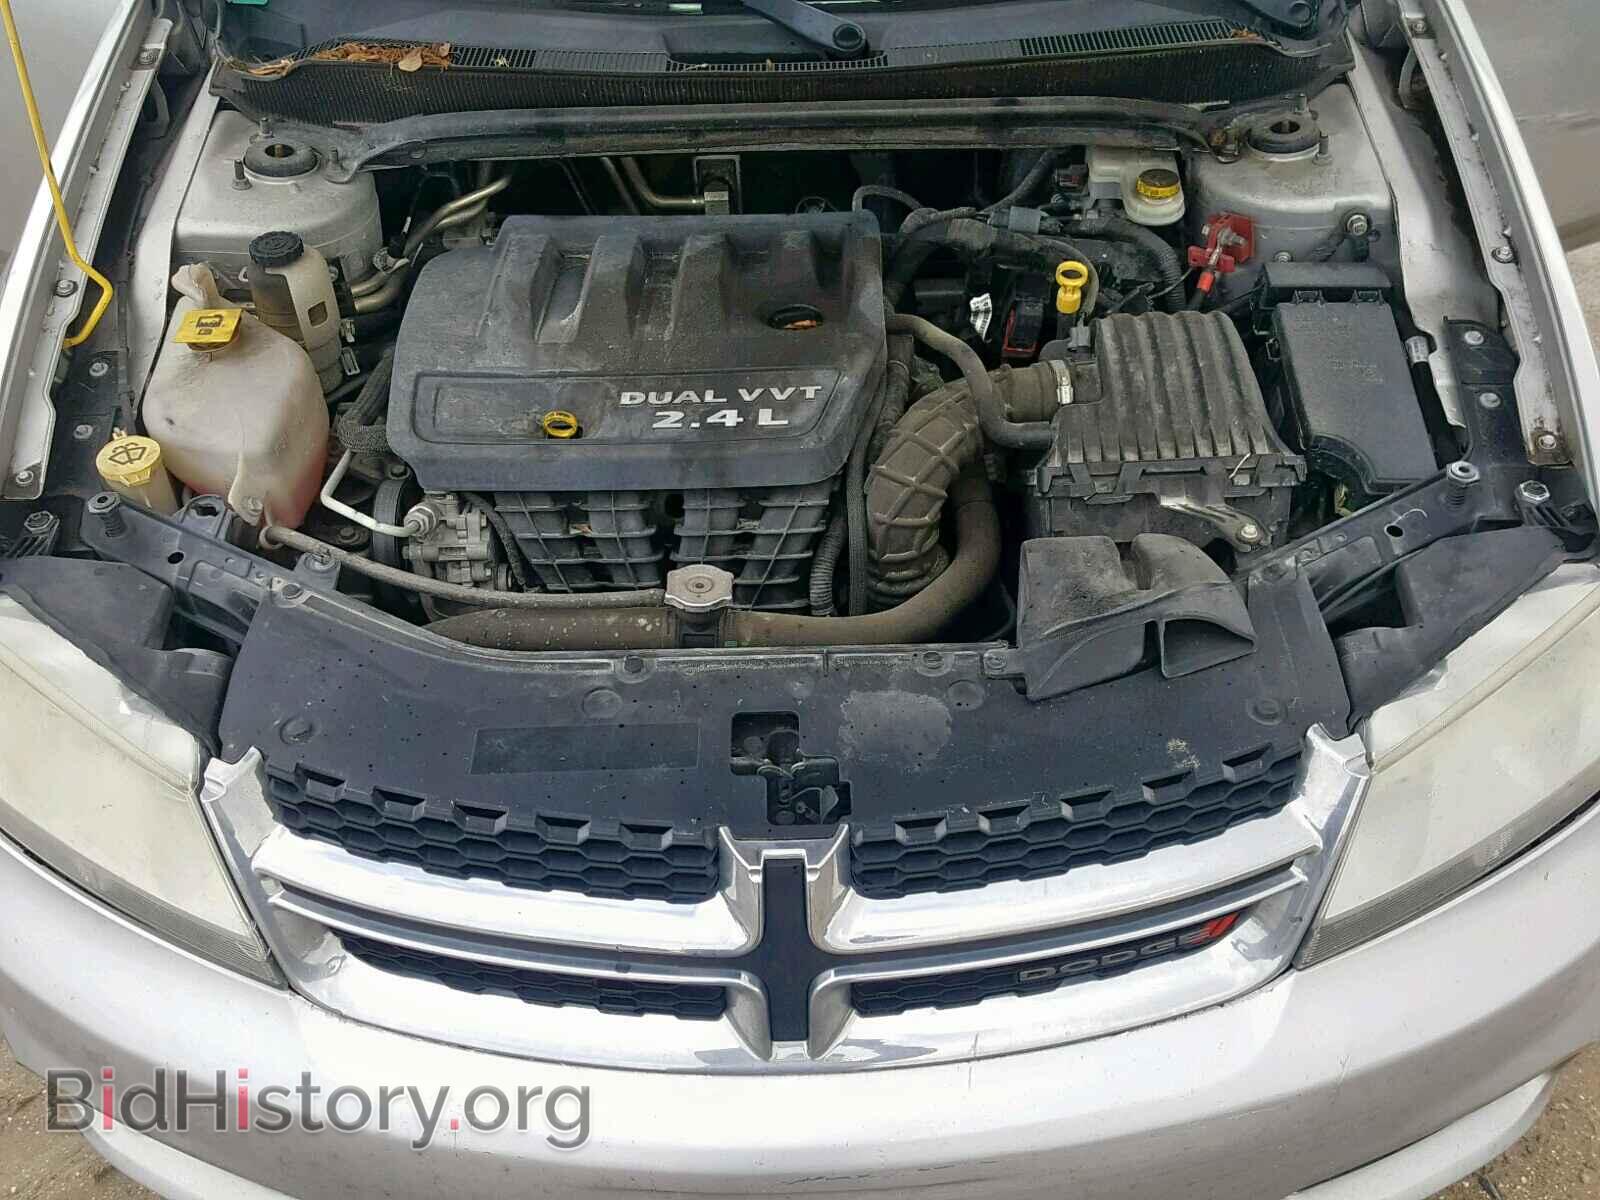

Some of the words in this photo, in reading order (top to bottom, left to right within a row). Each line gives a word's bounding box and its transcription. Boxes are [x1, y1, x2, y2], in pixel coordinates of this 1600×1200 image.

[619, 389, 728, 406] DUAL
[738, 385, 823, 402] VVT
[651, 410, 745, 429] 2.4
[757, 408, 790, 426] L
[1018, 930, 1211, 983] DODGE
